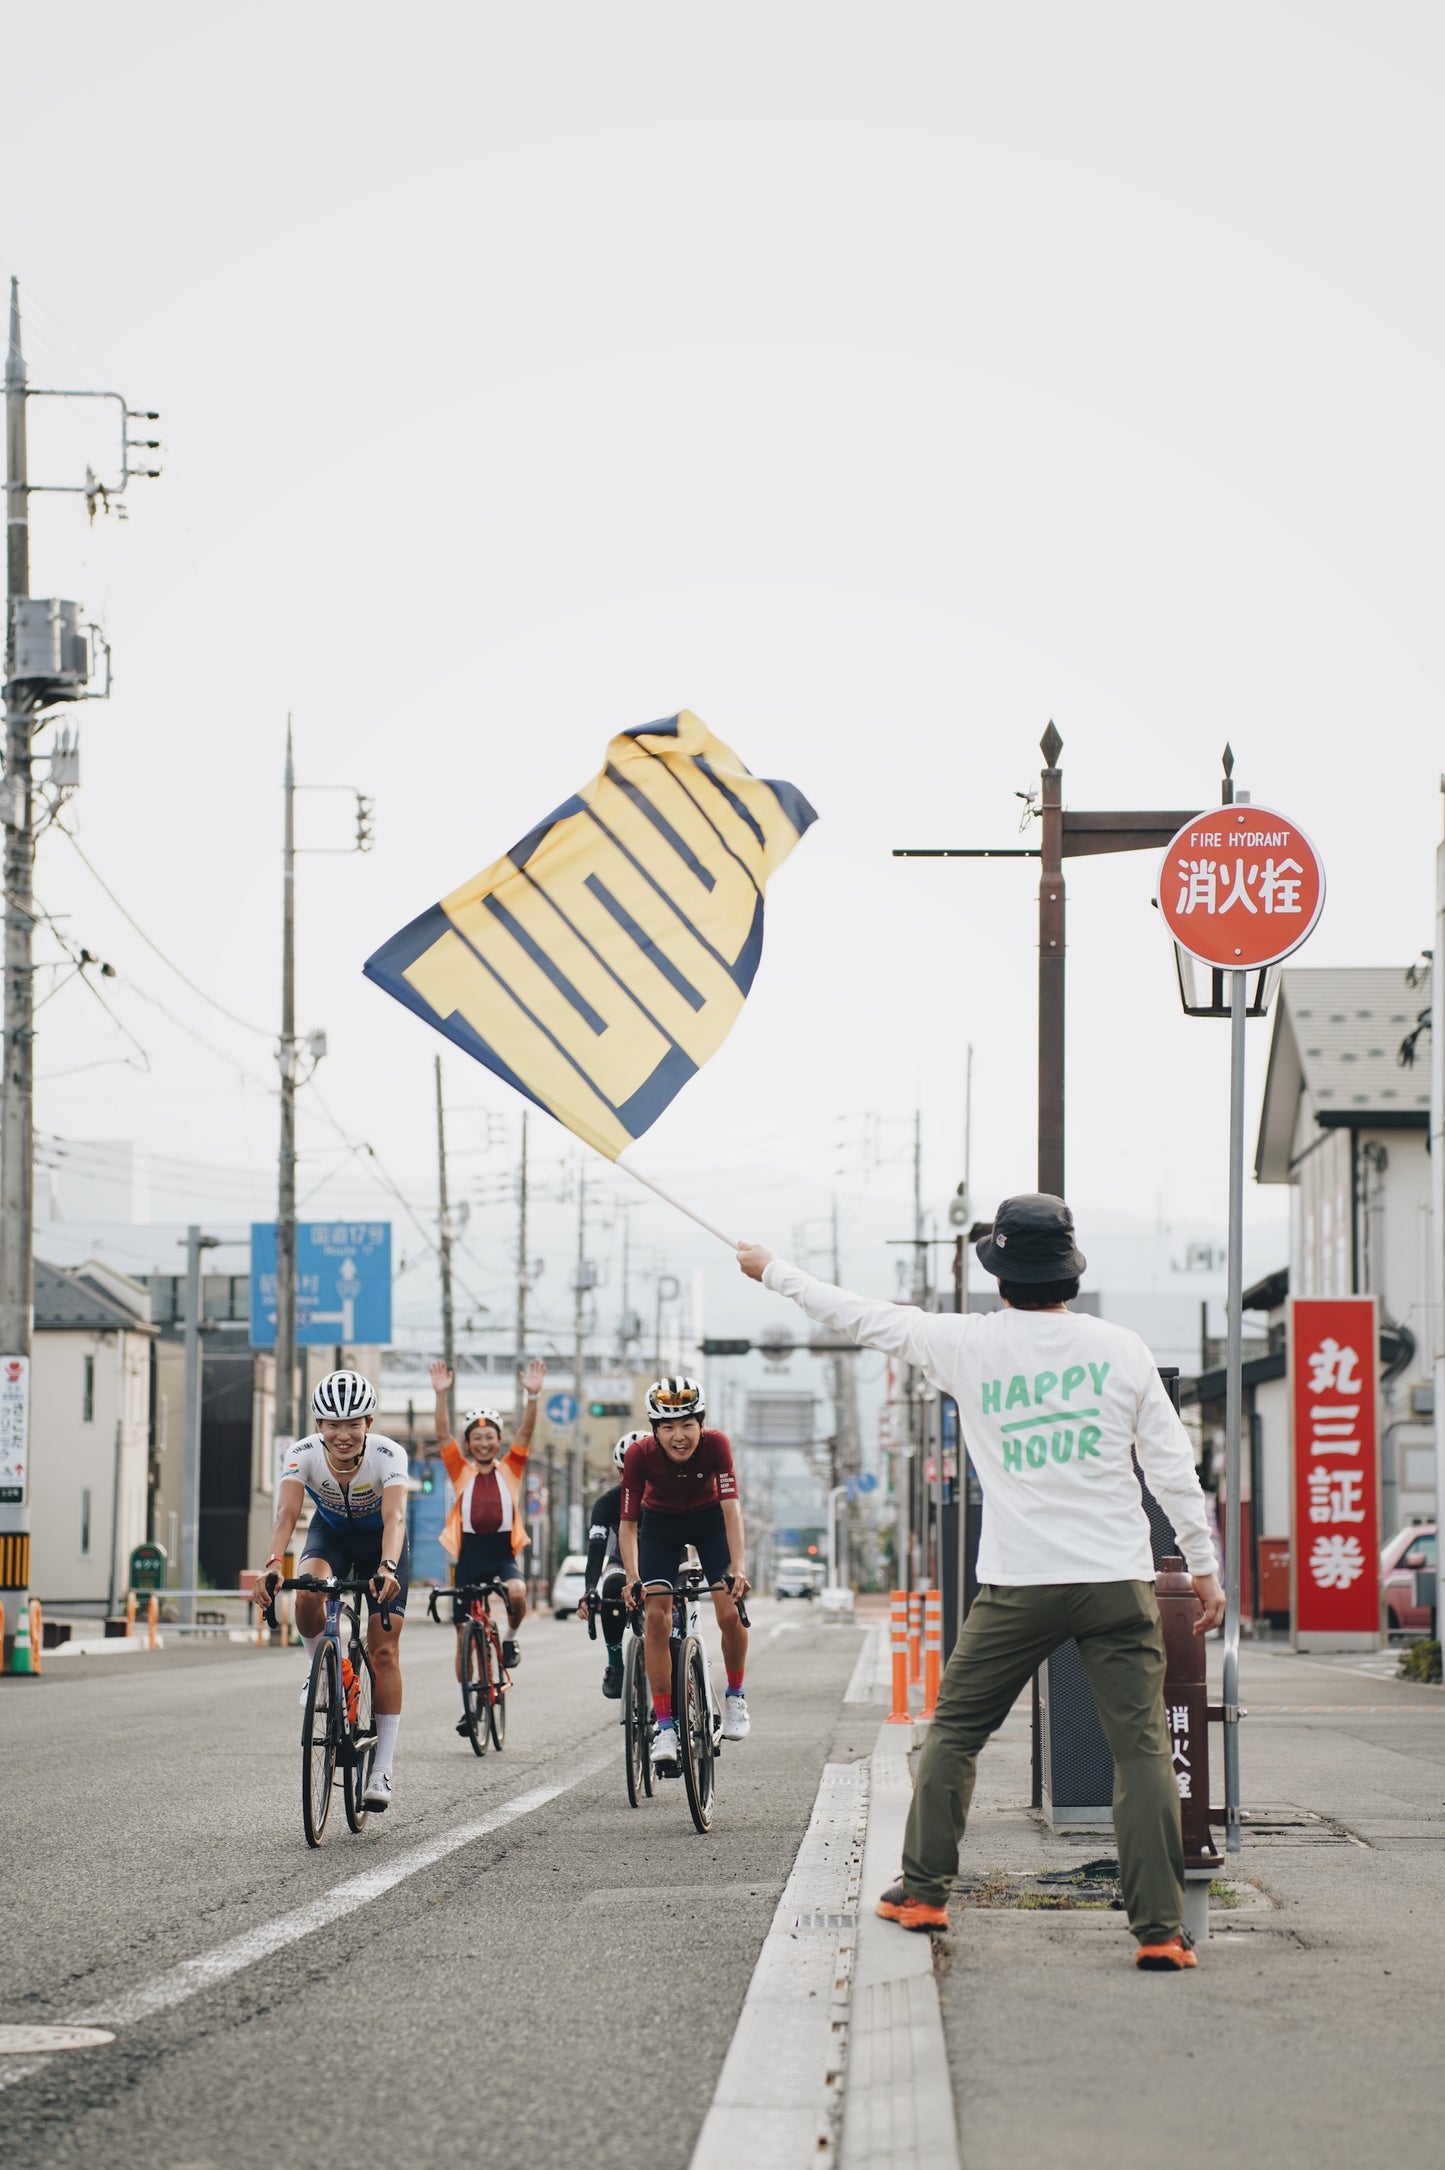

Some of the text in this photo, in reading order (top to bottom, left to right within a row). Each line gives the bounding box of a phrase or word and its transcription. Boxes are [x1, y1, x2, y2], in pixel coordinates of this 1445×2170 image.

[1190, 831, 1290, 848] FIRE HYDRANT
[1175, 857, 1304, 915] 消火栓
[311, 1224, 384, 1245] 国道17号
[323, 1245, 356, 1256] Route
[981, 1361, 1111, 1415] HAPPY
[1002, 1425, 1103, 1472] HOUR
[1307, 1337, 1365, 1590] 丸三証券
